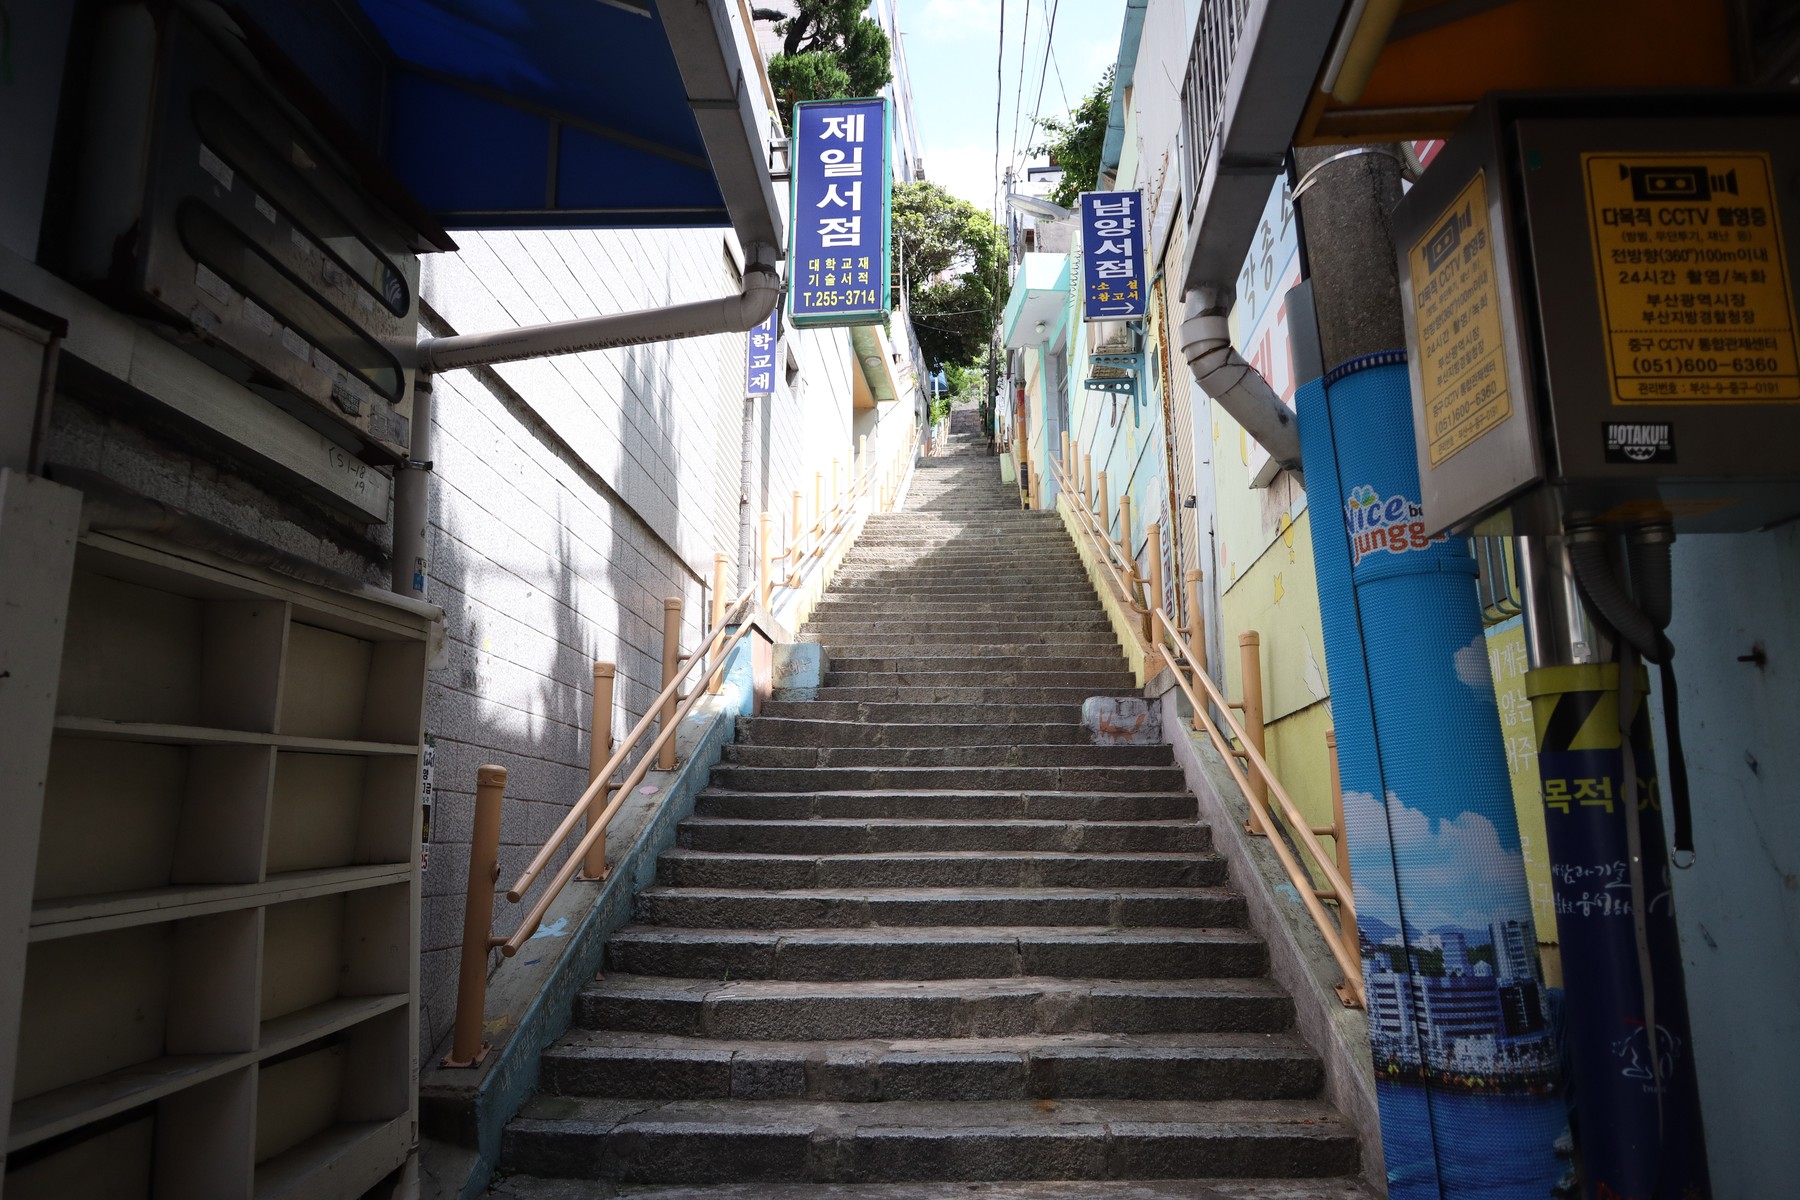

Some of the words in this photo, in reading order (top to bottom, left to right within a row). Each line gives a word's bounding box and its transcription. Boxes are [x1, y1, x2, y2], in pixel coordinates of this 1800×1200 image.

[816, 114, 865, 247] 제일서점
[1602, 207, 1652, 227] 다목적
[1658, 207, 1709, 226] CCTV
[1717, 207, 1767, 227] 촬영중
[1093, 197, 1136, 279] 남양서점
[808, 256, 870, 272] 대학교재
[1418, 278, 1438, 309] 다목적
[1439, 254, 1461, 287] CCTV
[1463, 228, 1486, 264] 촬영중
[808, 272, 870, 287] 기술서적
[1618, 270, 1676, 284] 24시간
[1686, 269, 1767, 285] 촬영/녹화
[803, 289, 876, 307] T.255-3714
[1097, 290, 1139, 302] 참고서
[1646, 293, 1746, 307] 부산광역시장
[1642, 310, 1755, 325] 부산지방경찰청장
[1426, 330, 1450, 358] 24시간
[1438, 326, 1481, 369] 부산광역시장
[1628, 338, 1655, 352] 중구
[1658, 338, 1694, 351] CCTV
[1699, 337, 1777, 352] 통합관제센터
[1633, 357, 1777, 375] (051)600-6360
[1638, 382, 1678, 395] 관리번호
[1435, 380, 1497, 436] (051)600-6360
[1608, 425, 1669, 445] !!OTAKU!!
[1354, 522, 1445, 564] jungg
